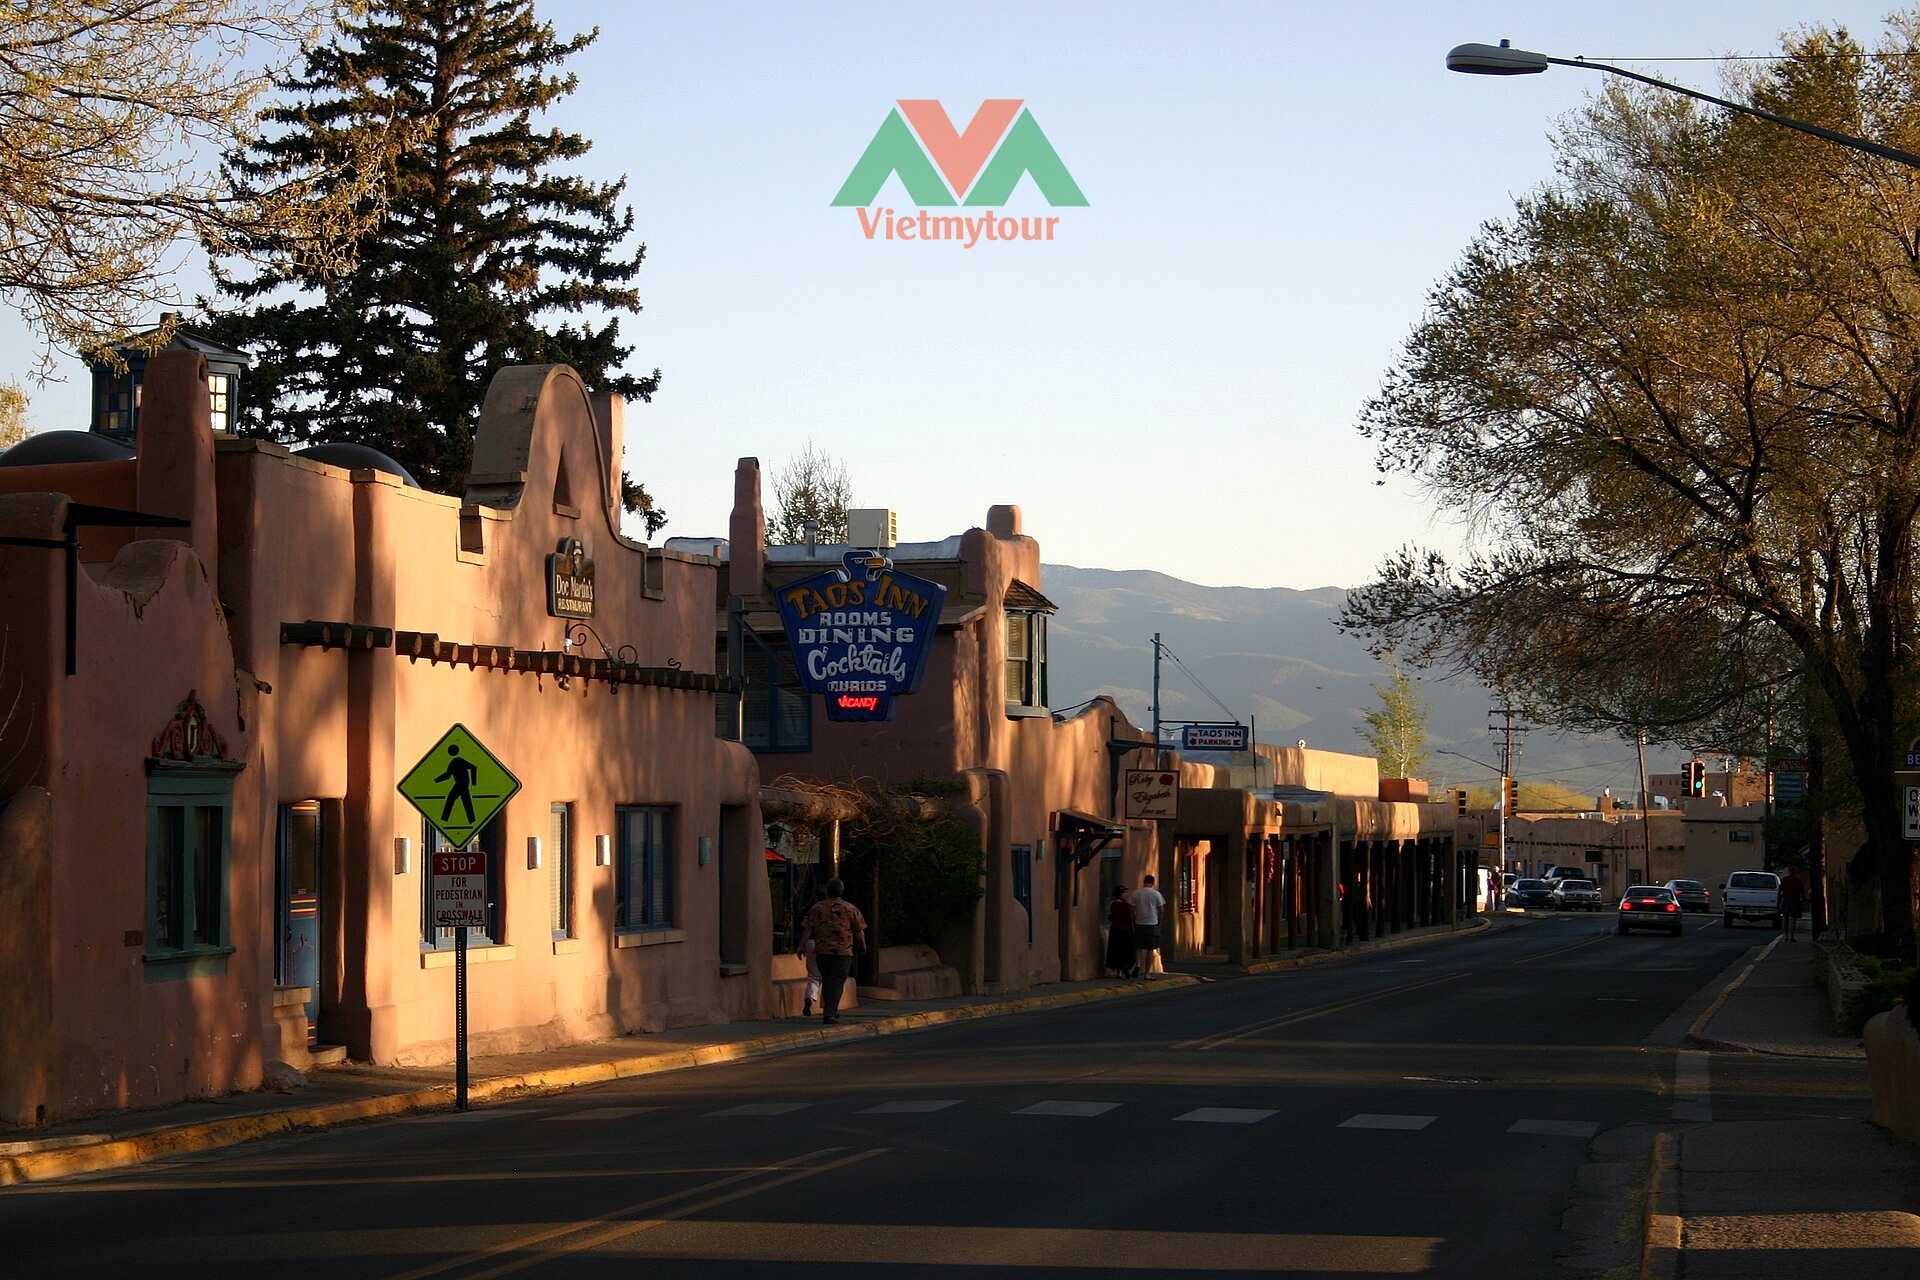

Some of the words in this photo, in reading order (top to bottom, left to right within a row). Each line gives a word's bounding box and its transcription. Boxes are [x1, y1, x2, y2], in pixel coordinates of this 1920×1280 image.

[556, 574, 570, 596] Doc
[786, 580, 866, 619] TAOS
[873, 575, 929, 619] INN
[558, 598, 592, 613] RESTAURANT
[819, 611, 892, 627] ROOMS
[798, 627, 915, 645] DINING
[807, 644, 907, 683] Cocktails
[837, 695, 879, 711] VACANCY
[1198, 729, 1223, 738] TAOS
[1224, 730, 1242, 739] INN
[1198, 738, 1232, 746] PARKING
[1128, 773, 1153, 787] Ruby
[1133, 789, 1171, 804] Elizabeth
[441, 857, 476, 871] STOP
[451, 877, 467, 888] FOR
[435, 889, 483, 901] PEDESTRIAN
[455, 901, 464, 909] IN
[436, 910, 483, 920] CROSSWALK
